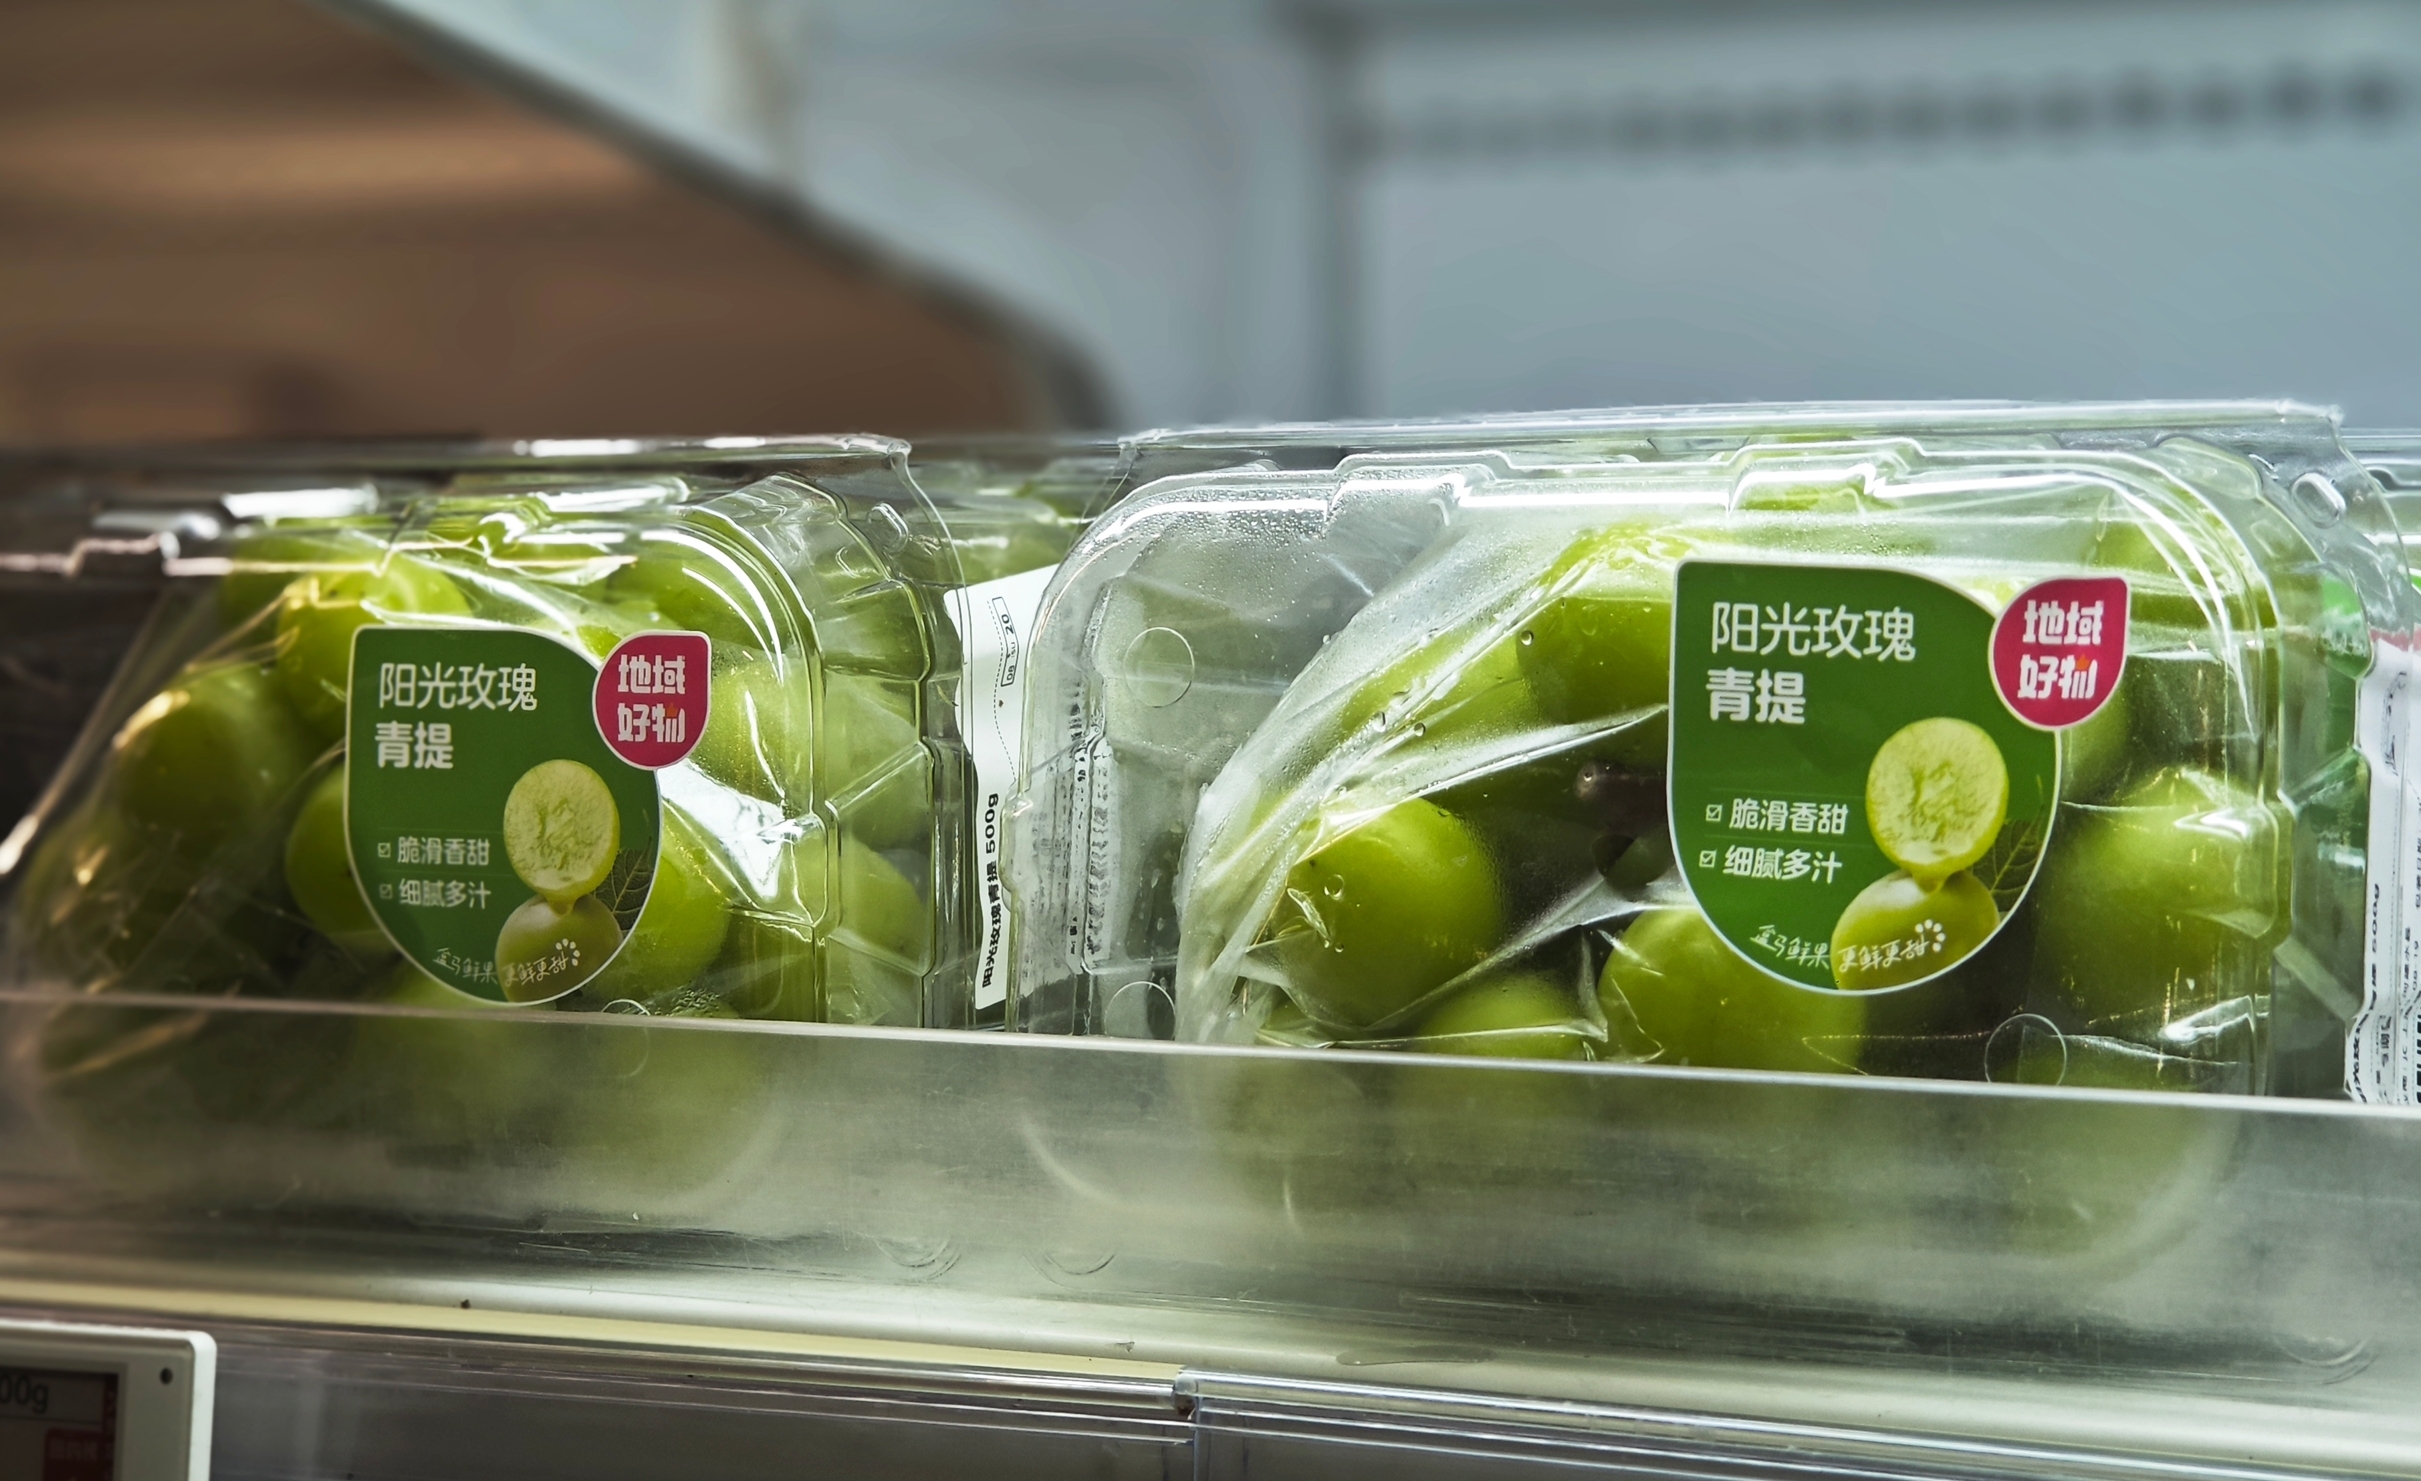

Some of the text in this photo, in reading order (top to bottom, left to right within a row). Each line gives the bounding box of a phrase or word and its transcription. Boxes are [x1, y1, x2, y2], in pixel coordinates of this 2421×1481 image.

[1712, 601, 1917, 662] 阳光玫瑰
[2021, 599, 2105, 647] 地域
[379, 660, 539, 713] 阳光玫瑰
[617, 653, 687, 695] 地域
[1705, 665, 1807, 726] 青提
[2017, 654, 2098, 700] 好物
[374, 719, 455, 770] 青提
[616, 702, 687, 743] 好物
[1728, 798, 1850, 836] 脆滑香甜
[397, 836, 491, 867] 脆滑香甜
[1722, 845, 1844, 885] 细腻多汁
[398, 877, 492, 910] 细腻多汁
[981, 792, 1002, 989] 阳光玫瑰青提 500g
[432, 946, 569, 987] 盒马鲜果 更鲜更甜
[1749, 924, 1931, 974] 盒马鲜果 更鲜更甜
